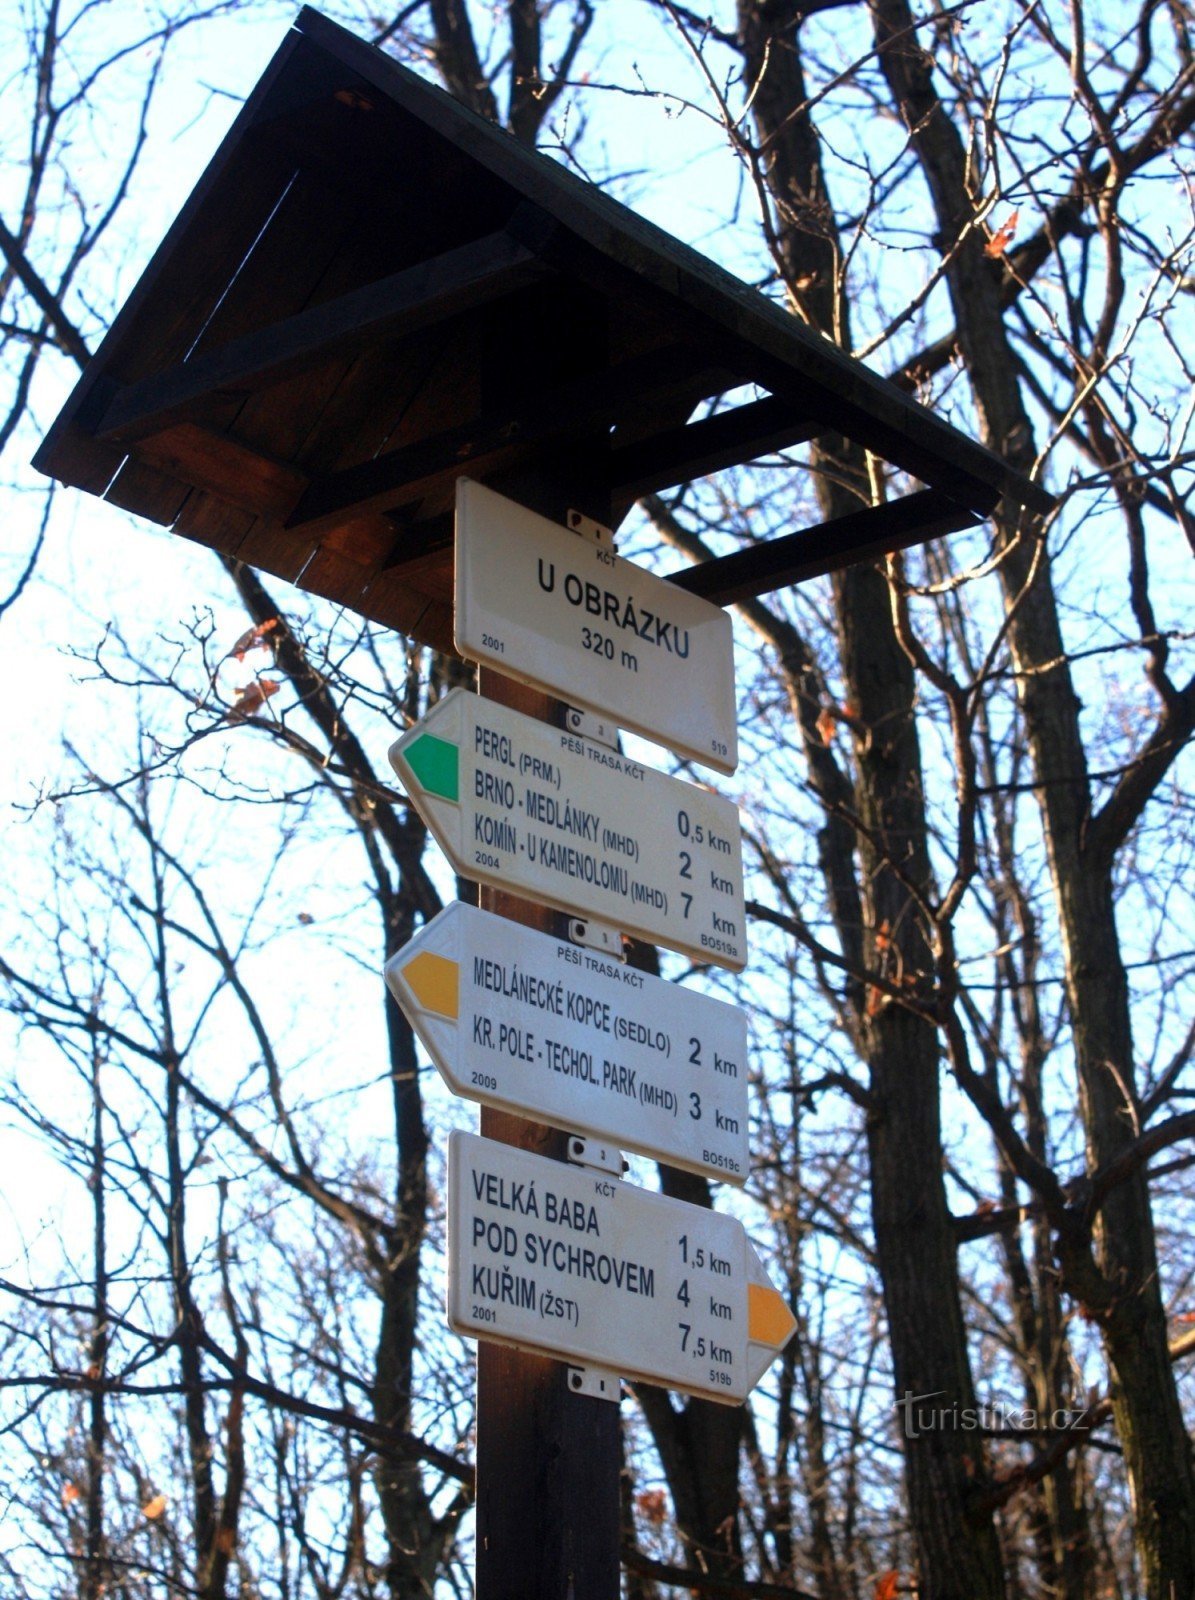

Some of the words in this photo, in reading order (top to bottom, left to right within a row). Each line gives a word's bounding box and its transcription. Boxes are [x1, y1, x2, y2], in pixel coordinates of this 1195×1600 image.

[596, 550, 617, 568] KČT
[538, 558, 555, 593] U
[564, 573, 689, 659] OBRÁZKU
[482, 633, 505, 653] 2001
[581, 627, 614, 660] 320
[622, 651, 638, 672] m
[561, 736, 585, 756] PĚŠÍ
[587, 748, 622, 772] TRASA
[625, 763, 645, 781] KČT
[711, 740, 728, 756] 519
[475, 725, 515, 767] PERGL
[519, 753, 561, 790] (PRM.)
[677, 810, 704, 845] 0,5
[708, 830, 731, 855] km
[475, 769, 514, 810] BRNO
[526, 789, 600, 842] MEDLÁNKY
[603, 828, 639, 863] (MHD)
[679, 851, 692, 879] 2
[711, 871, 734, 896] km
[475, 851, 500, 869] 2004
[475, 812, 516, 854] KOMÍN
[527, 832, 536, 861] U
[540, 840, 628, 896] KAMENOLOMU
[631, 879, 668, 915] (MHD)
[680, 892, 693, 919] 7
[712, 912, 736, 937] km
[557, 945, 582, 966] PĚŠÍ
[586, 957, 620, 981] TRASA
[623, 971, 645, 989] KČT
[474, 956, 563, 1016] MEDLÁNECKÉ
[567, 991, 611, 1033] KOPCE
[614, 1015, 671, 1058] (SEDLO)
[688, 1037, 702, 1066] 2
[714, 1053, 737, 1078] km
[472, 1071, 497, 1090] 2009
[473, 1014, 495, 1050] KR.
[500, 1023, 534, 1063] POLE
[545, 1039, 600, 1086] TECHOL.
[603, 1060, 636, 1099] PARK
[639, 1082, 678, 1117] (MHD)
[689, 1092, 701, 1121] 3
[715, 1110, 738, 1135] km
[595, 1181, 616, 1199] KČT
[472, 1169, 539, 1218] VELKÁ
[545, 1192, 600, 1237] BABA
[678, 1234, 704, 1269] 1,5
[710, 1252, 731, 1277] km
[473, 1217, 517, 1257] POD
[525, 1232, 654, 1298] SYCHROVEM
[677, 1279, 690, 1308] 4
[710, 1297, 732, 1321] km
[472, 1305, 496, 1323] 2001
[472, 1264, 535, 1310] KUŘIM
[540, 1289, 579, 1327] (ŽST)
[678, 1323, 705, 1357] 7,5
[711, 1341, 732, 1365] km
[709, 1369, 732, 1386] 519b
